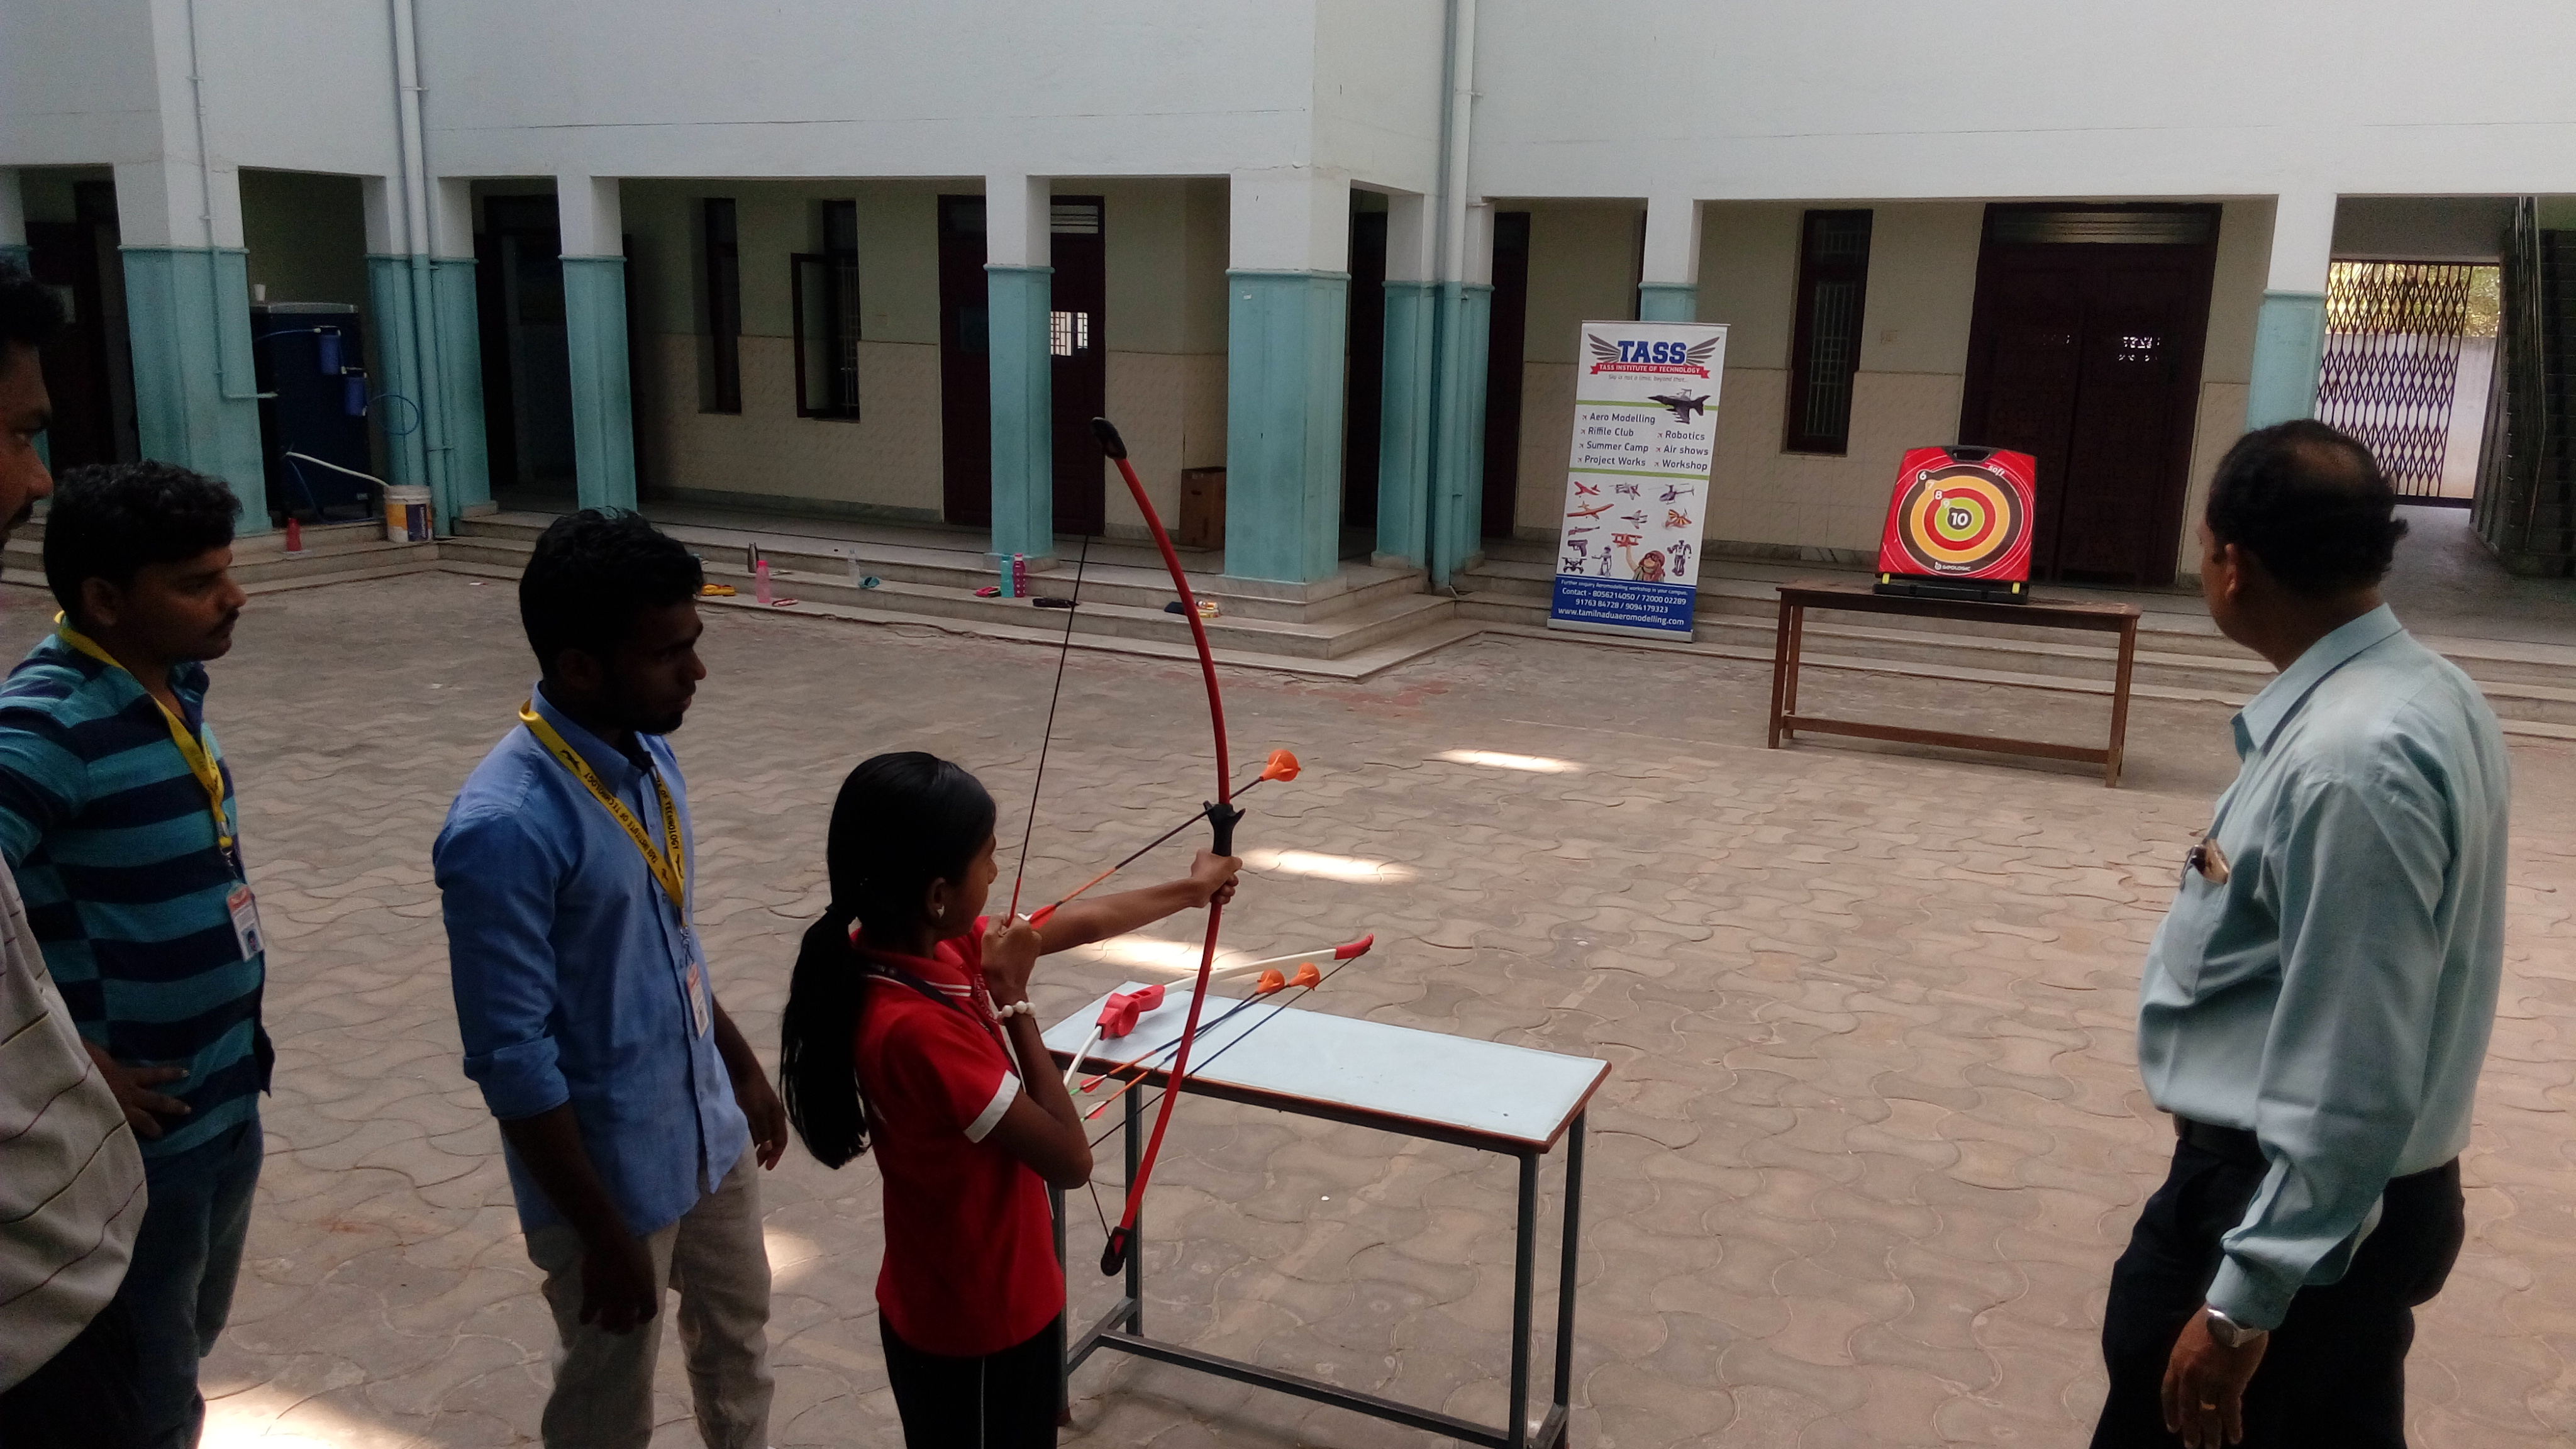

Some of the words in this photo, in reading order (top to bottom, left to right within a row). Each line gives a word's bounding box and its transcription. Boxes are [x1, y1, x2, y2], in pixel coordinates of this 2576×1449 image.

[1618, 340, 1687, 364] TASS
[1590, 413, 1609, 421] Aero
[1612, 413, 1655, 425] Modelling
[1614, 428, 1634, 436] Club
[1665, 430, 1705, 440] Robotics
[1587, 441, 1622, 450] Summer
[1624, 443, 1648, 453] Camp
[1663, 445, 1677, 453] Air
[1679, 446, 1708, 455] shows
[1585, 455, 1615, 465] Project
[1618, 457, 1646, 466] Works
[1662, 459, 1707, 472] Workshop
[1919, 471, 1927, 480] 6
[1988, 465, 2005, 476] soft
[1926, 480, 1935, 490] 7
[1935, 491, 1943, 500] 8
[1943, 497, 1950, 509] 9
[1951, 512, 1968, 526] 10
[1562, 587, 1587, 596] Contact
[1592, 590, 1635, 601] 8056214050
[1641, 594, 1663, 603] 72000
[1664, 597, 1687, 605] 02289
[1575, 599, 1596, 607] 91763
[1597, 601, 1619, 609] 84728
[1625, 602, 1668, 613] 9094179323
[1558, 608, 1684, 626] www.tamilnaduaeromodelling.com
